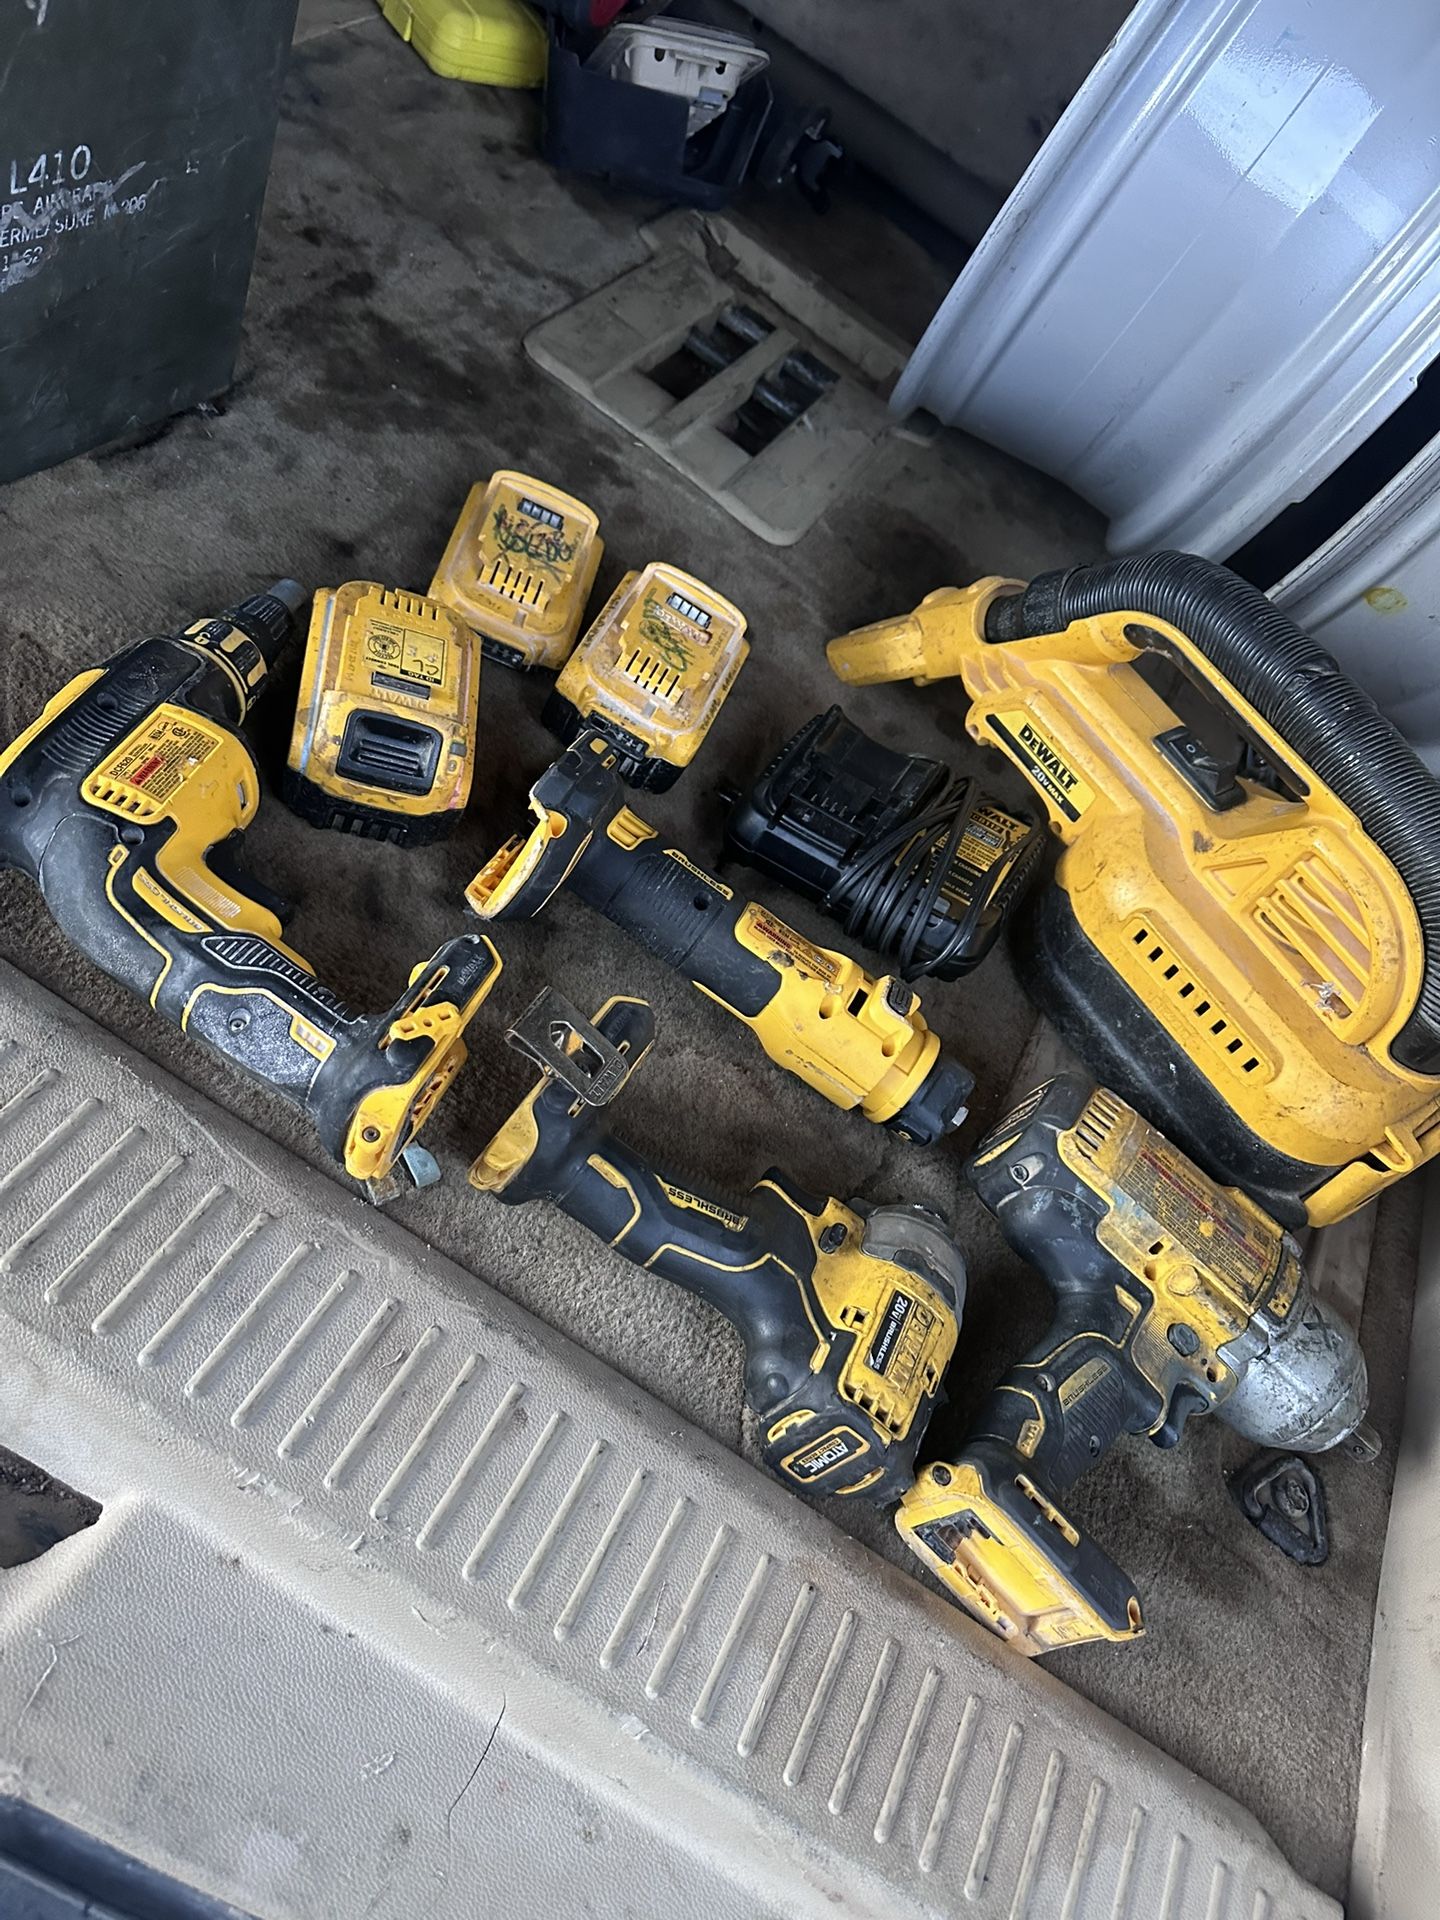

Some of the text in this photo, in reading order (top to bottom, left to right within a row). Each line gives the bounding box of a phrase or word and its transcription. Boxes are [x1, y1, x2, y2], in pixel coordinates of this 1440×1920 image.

[1018, 723, 1078, 793] DEWALT
[971, 813, 1001, 833] CB112
[977, 804, 1018, 832] WALT
[670, 850, 730, 896] BRUSHLESS
[667, 1186, 741, 1224] BRUSHLESS
[871, 1320, 896, 1370] BRUSHLESS
[885, 1305, 935, 1394] DEWALT
[1060, 1363, 1108, 1407] BRUSHLESS
[804, 1441, 849, 1474] ATOMIC
